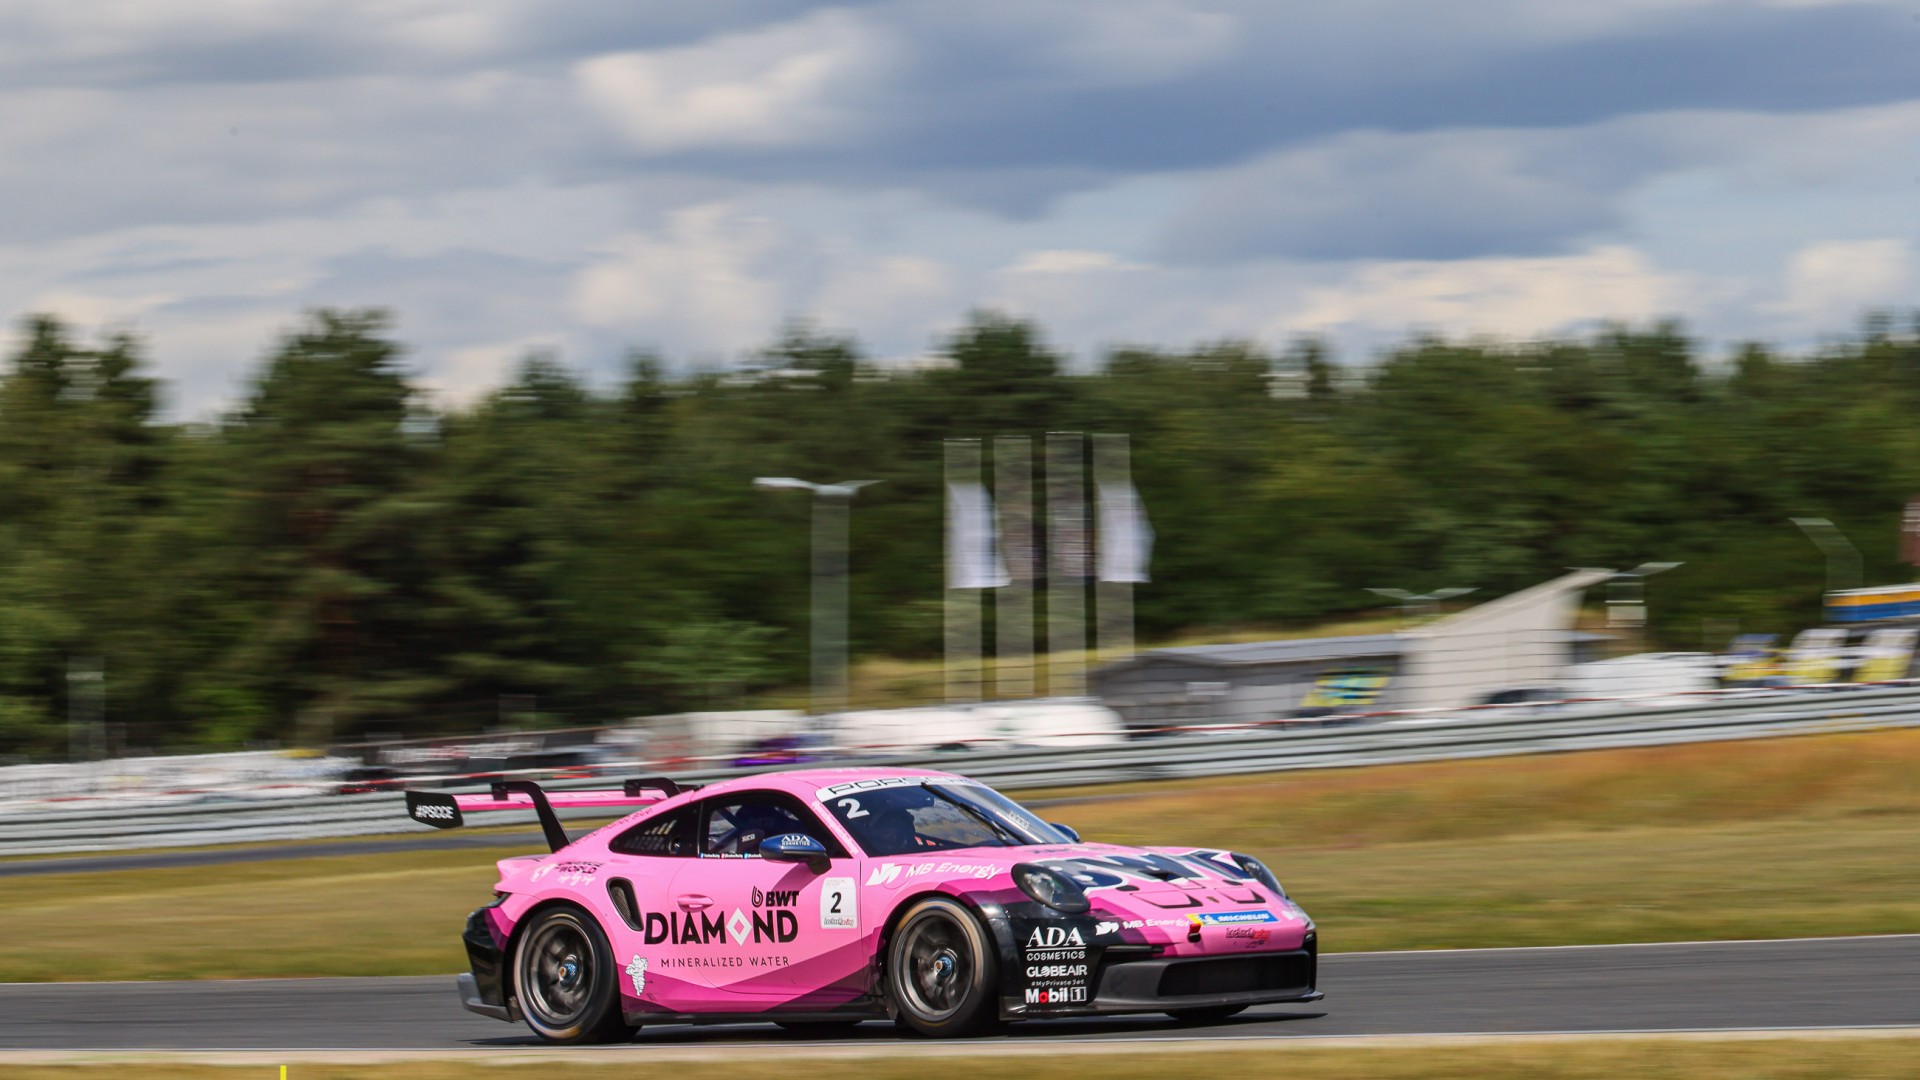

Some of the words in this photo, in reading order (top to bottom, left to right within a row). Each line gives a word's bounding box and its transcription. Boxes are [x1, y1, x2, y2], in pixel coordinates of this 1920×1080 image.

[837, 798, 870, 820] 2
[781, 834, 811, 842] ADA
[905, 863, 936, 878] MB
[935, 862, 1003, 880] Energy
[765, 890, 800, 908] BWT
[830, 891, 842, 914] 2
[1217, 912, 1271, 922] MICHELIN
[1122, 920, 1145, 930] MB
[1025, 926, 1088, 948] ADA
[660, 956, 744, 968] MINERALIZED
[748, 956, 791, 968] WATER
[1026, 950, 1086, 962] COSMETICS
[1026, 964, 1088, 978] GLOBEAIR
[1024, 987, 1069, 1004] Mobil
